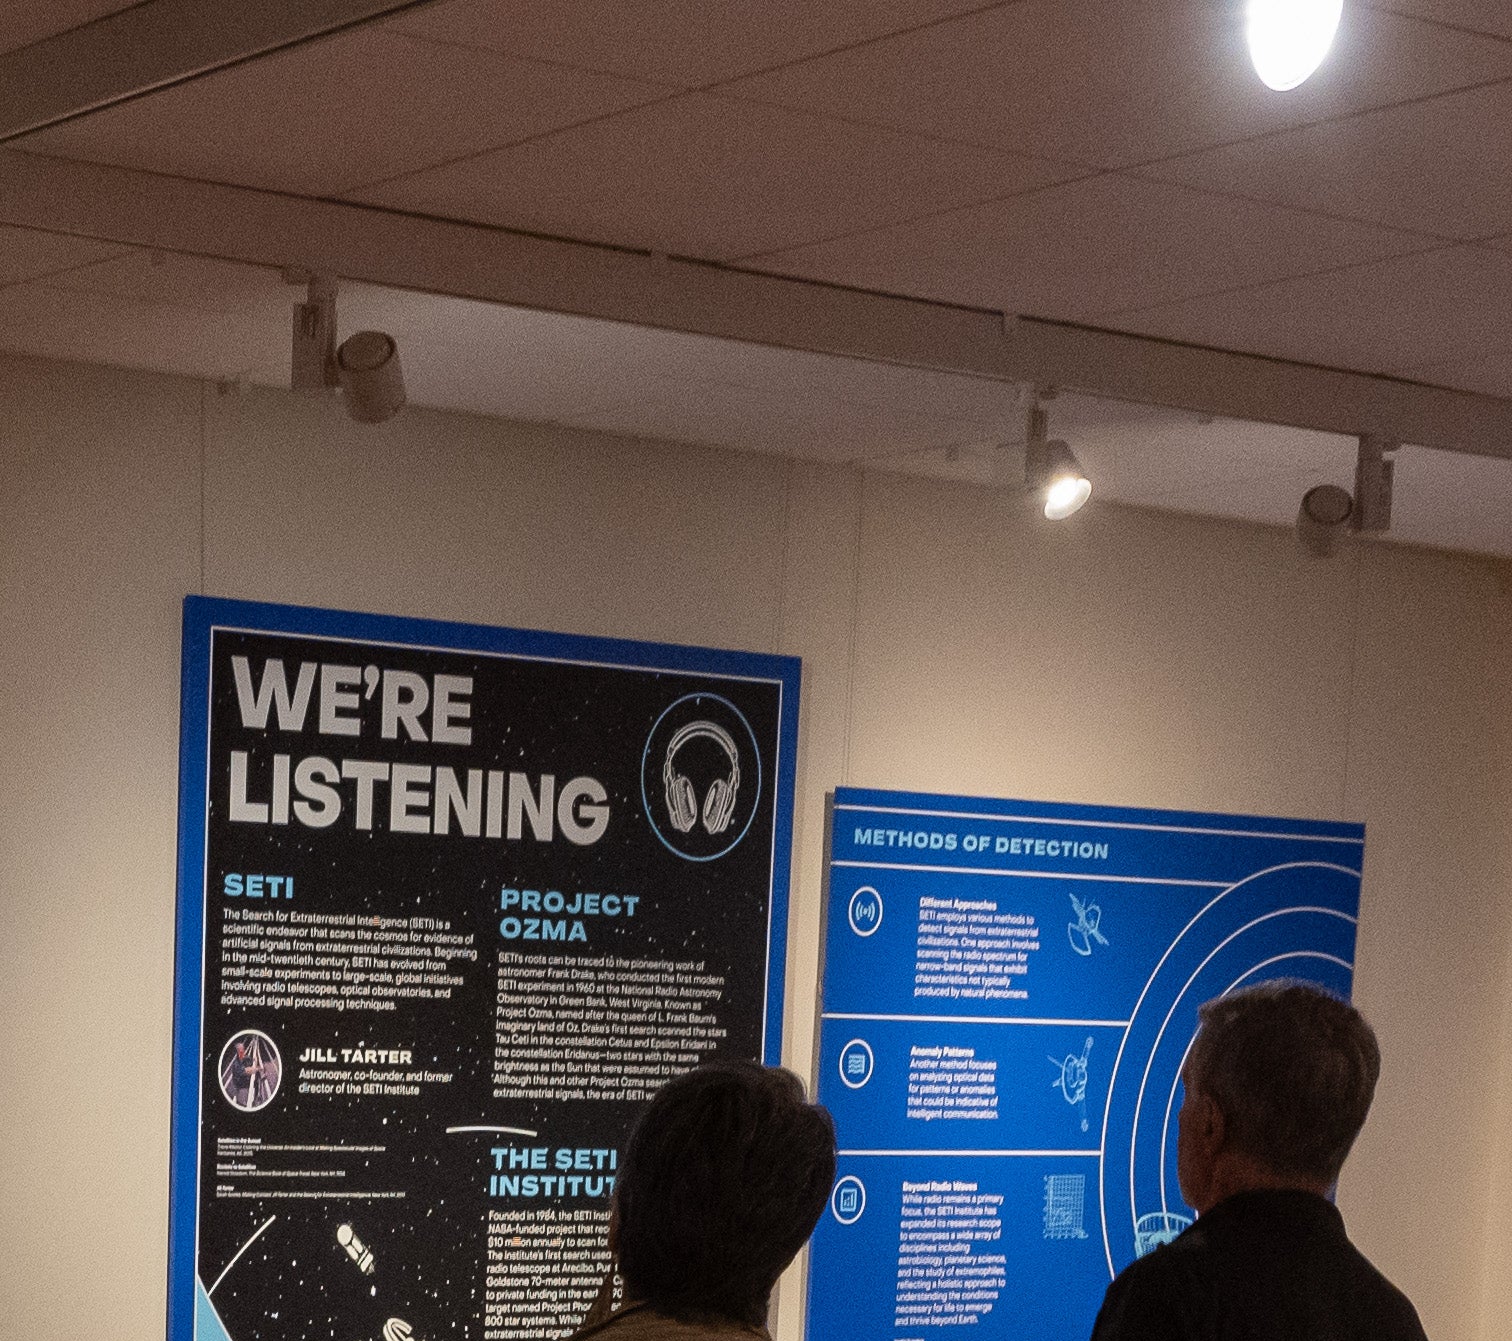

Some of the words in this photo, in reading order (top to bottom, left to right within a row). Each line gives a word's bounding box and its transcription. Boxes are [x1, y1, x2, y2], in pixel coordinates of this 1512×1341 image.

[230, 655, 475, 746] WE'RE
[228, 750, 611, 846] LISTENING
[853, 828, 958, 852] METHODS
[962, 833, 991, 854] OF
[995, 834, 1109, 860] DETECTION
[223, 873, 295, 899] SETI
[499, 888, 640, 917] PROJECT
[222, 922, 265, 935] scientific
[265, 924, 309, 937] endeavor
[309, 925, 328, 938] that
[329, 929, 356, 939] scans
[356, 928, 373, 940] the
[372, 931, 409, 942] cosmos
[409, 930, 423, 942] for
[423, 931, 464, 944] evidence
[464, 933, 475, 945] of
[499, 918, 589, 942] OZMA
[299, 1047, 337, 1063] JILL
[342, 1048, 413, 1064] TARTER
[298, 1067, 353, 1081] Astronomer,
[353, 1069, 405, 1082] co-founder,
[405, 1070, 423, 1082] and
[423, 1070, 453, 1083] former
[298, 1082, 335, 1094] director
[335, 1082, 346, 1094] of
[346, 1082, 362, 1094] the
[362, 1083, 383, 1094] SETI
[383, 1083, 420, 1095] Institute
[490, 1148, 548, 1170] THE
[555, 1148, 618, 1171] SETI
[489, 1174, 617, 1198] INSTITUT
